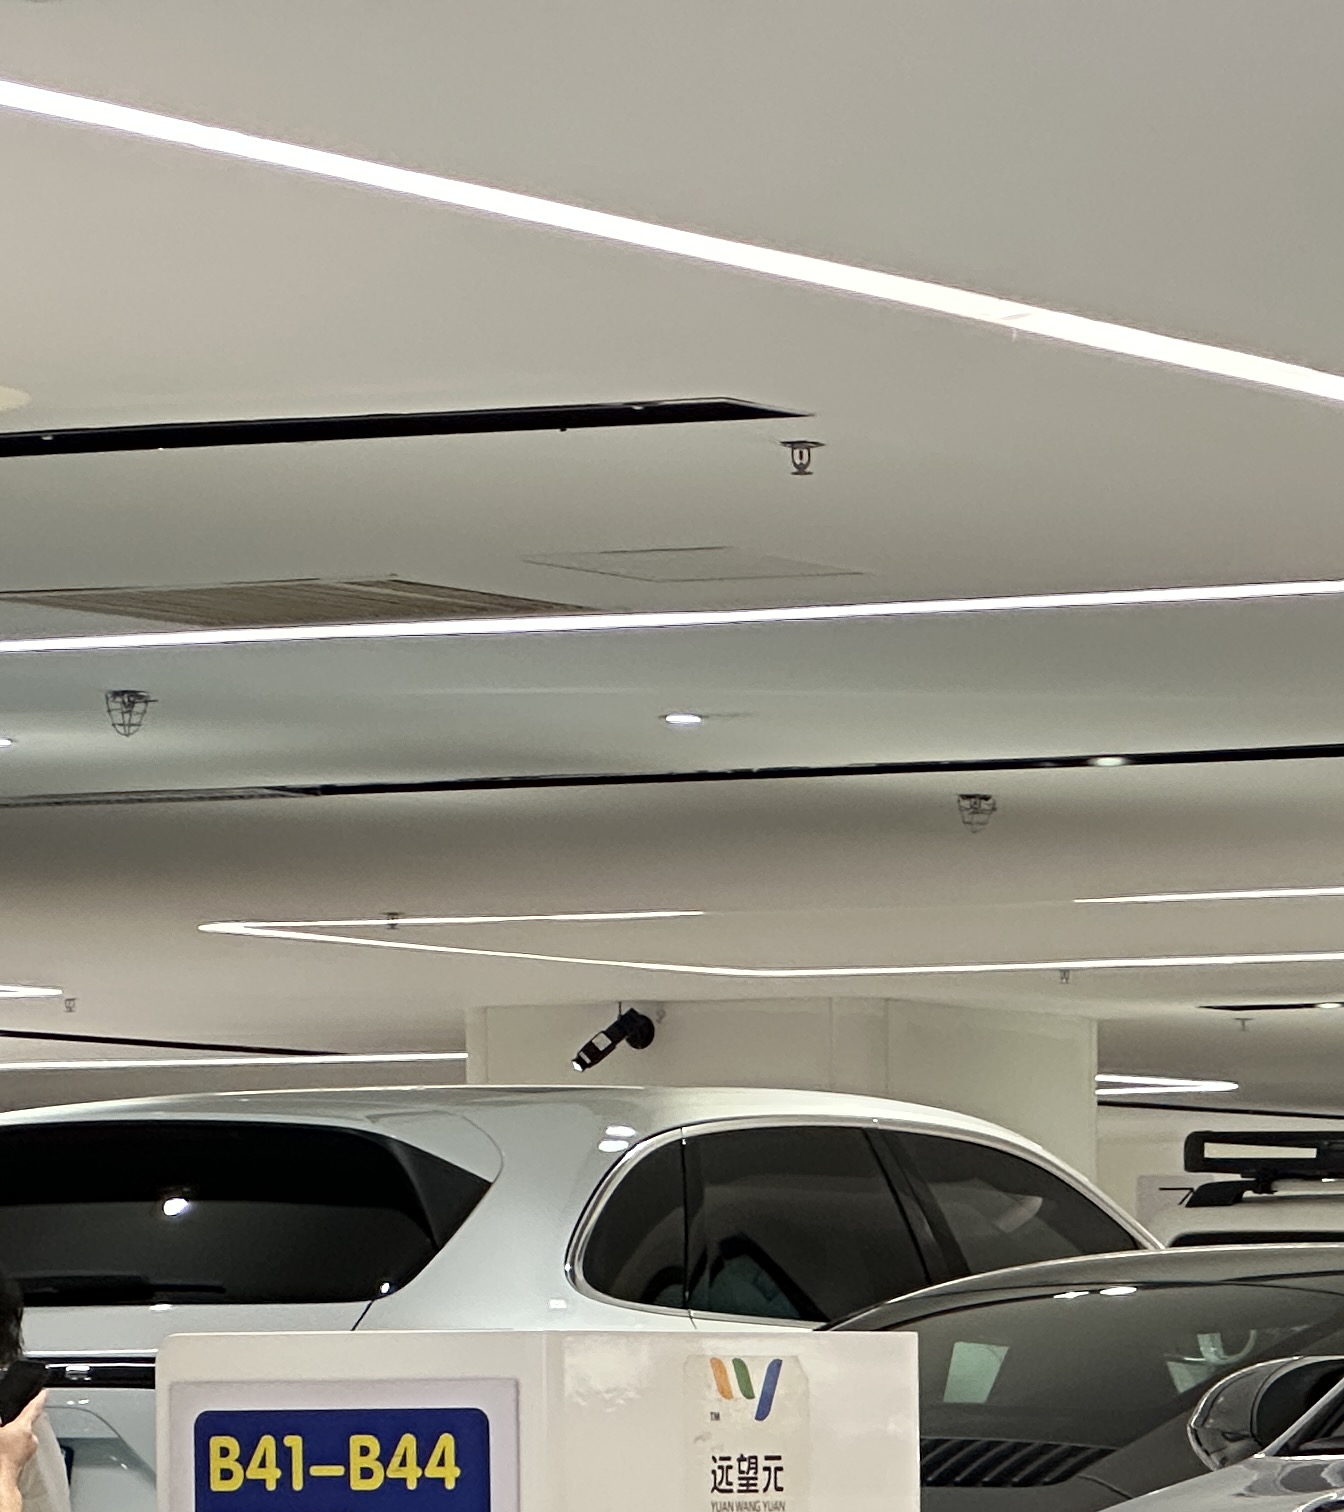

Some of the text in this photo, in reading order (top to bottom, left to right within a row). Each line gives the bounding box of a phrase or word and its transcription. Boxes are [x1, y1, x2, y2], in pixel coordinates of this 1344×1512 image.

[209, 1433, 461, 1492] B41-B44
[711, 1453, 784, 1493] 远望元
[711, 1500, 785, 1512] YUAN WANG YUAN
